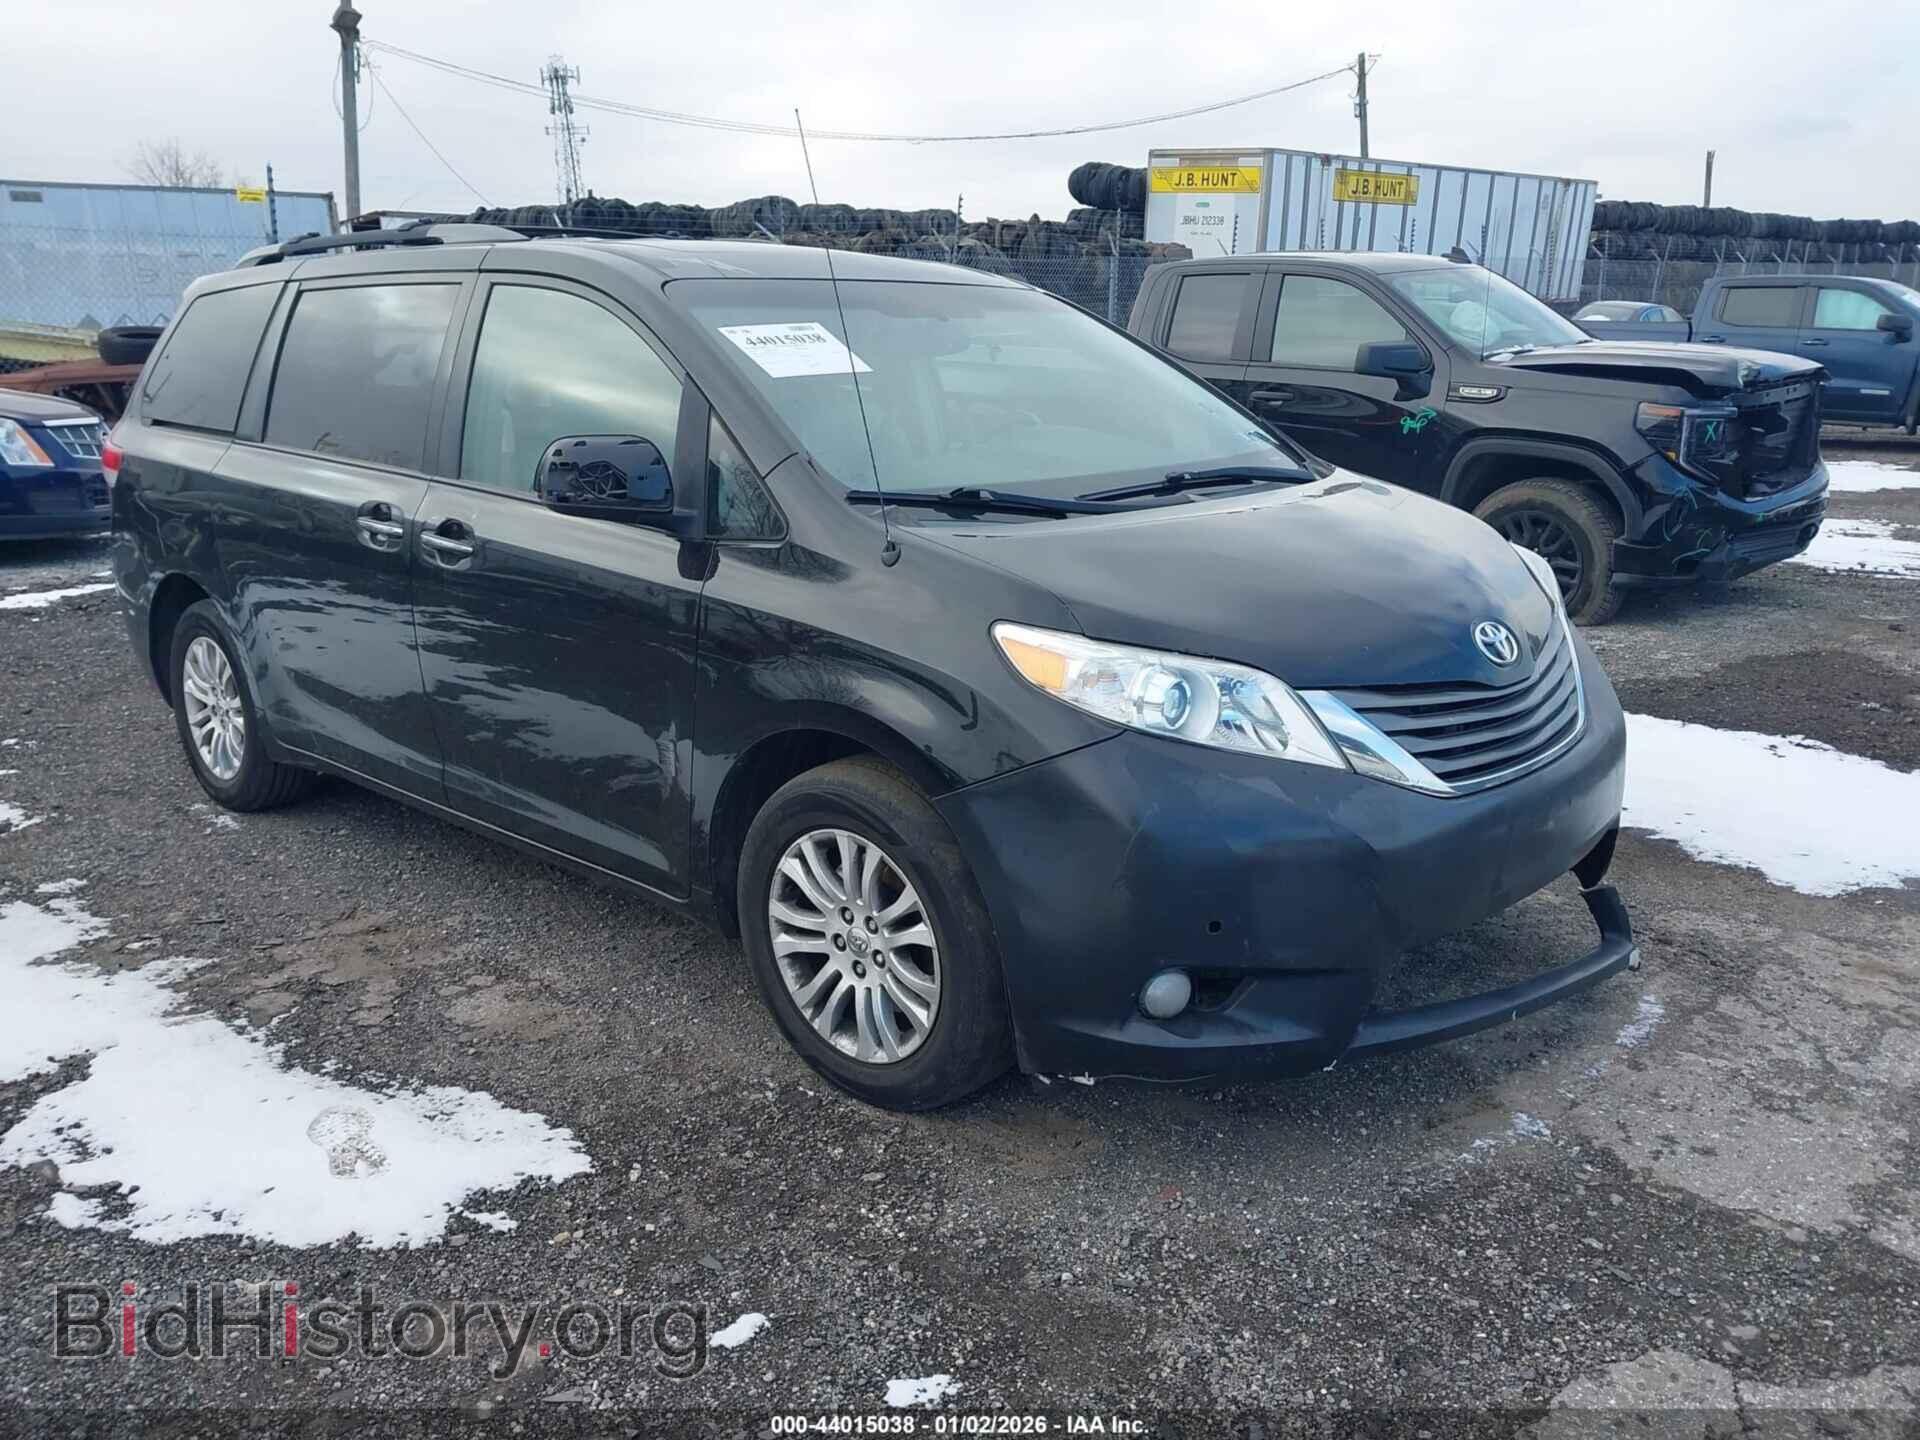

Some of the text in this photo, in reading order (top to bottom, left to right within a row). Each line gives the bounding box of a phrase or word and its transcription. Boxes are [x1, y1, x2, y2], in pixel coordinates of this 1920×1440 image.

[1174, 172, 1238, 187] J.B. HUNT
[1351, 177, 1404, 197] J.B. HUNT
[744, 333, 827, 346] 44015038
